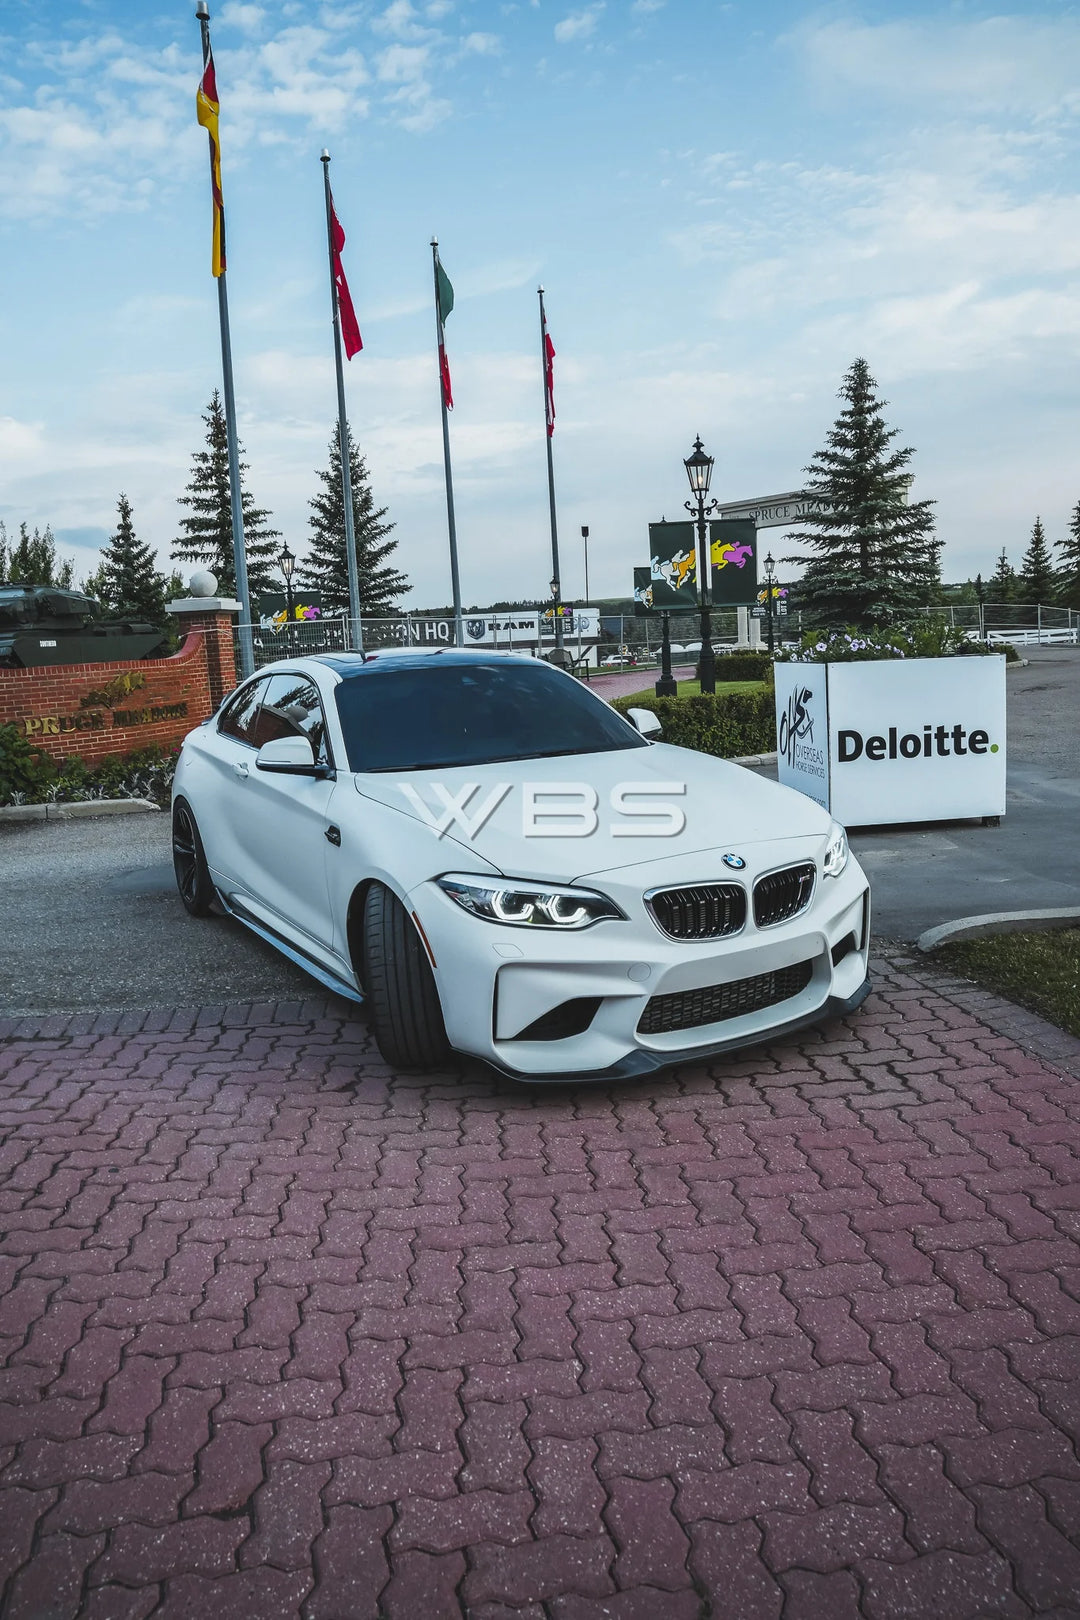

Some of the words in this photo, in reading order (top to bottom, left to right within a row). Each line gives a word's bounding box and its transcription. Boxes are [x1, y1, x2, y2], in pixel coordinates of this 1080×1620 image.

[749, 505, 790, 521] SPRUCE
[425, 622, 450, 641] HQ
[488, 621, 535, 631] RAM
[838, 724, 1000, 763] Deloitte.
[796, 744, 824, 765] OVERSEAS
